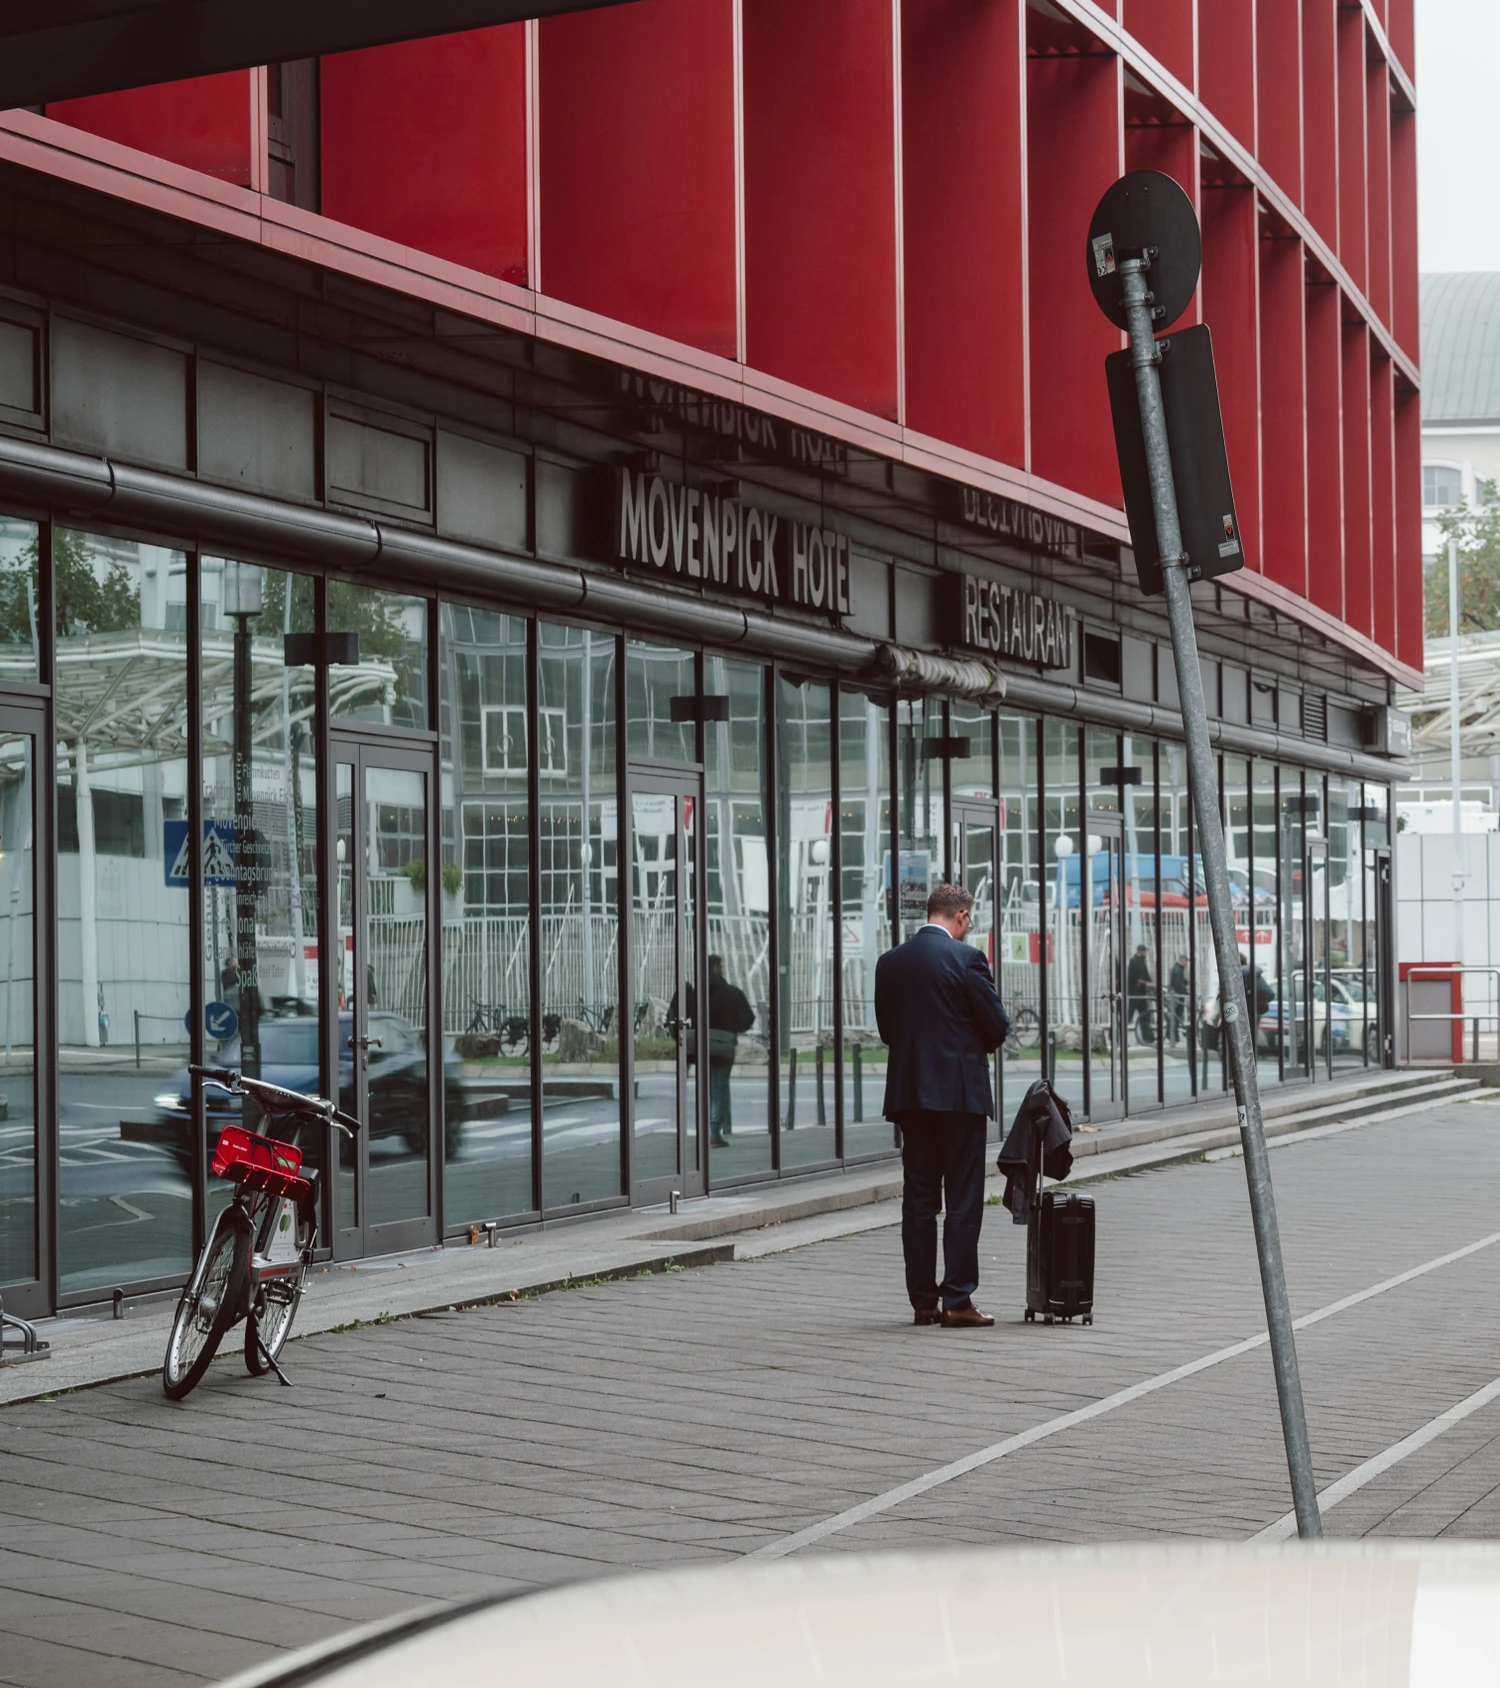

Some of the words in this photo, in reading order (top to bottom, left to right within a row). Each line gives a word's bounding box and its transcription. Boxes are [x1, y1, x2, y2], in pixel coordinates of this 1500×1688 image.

[619, 453, 779, 598] MÖVENPICK
[965, 574, 1077, 668] RESTAURANT
[235, 752, 243, 802] deftig
[235, 964, 258, 993] Spaß
